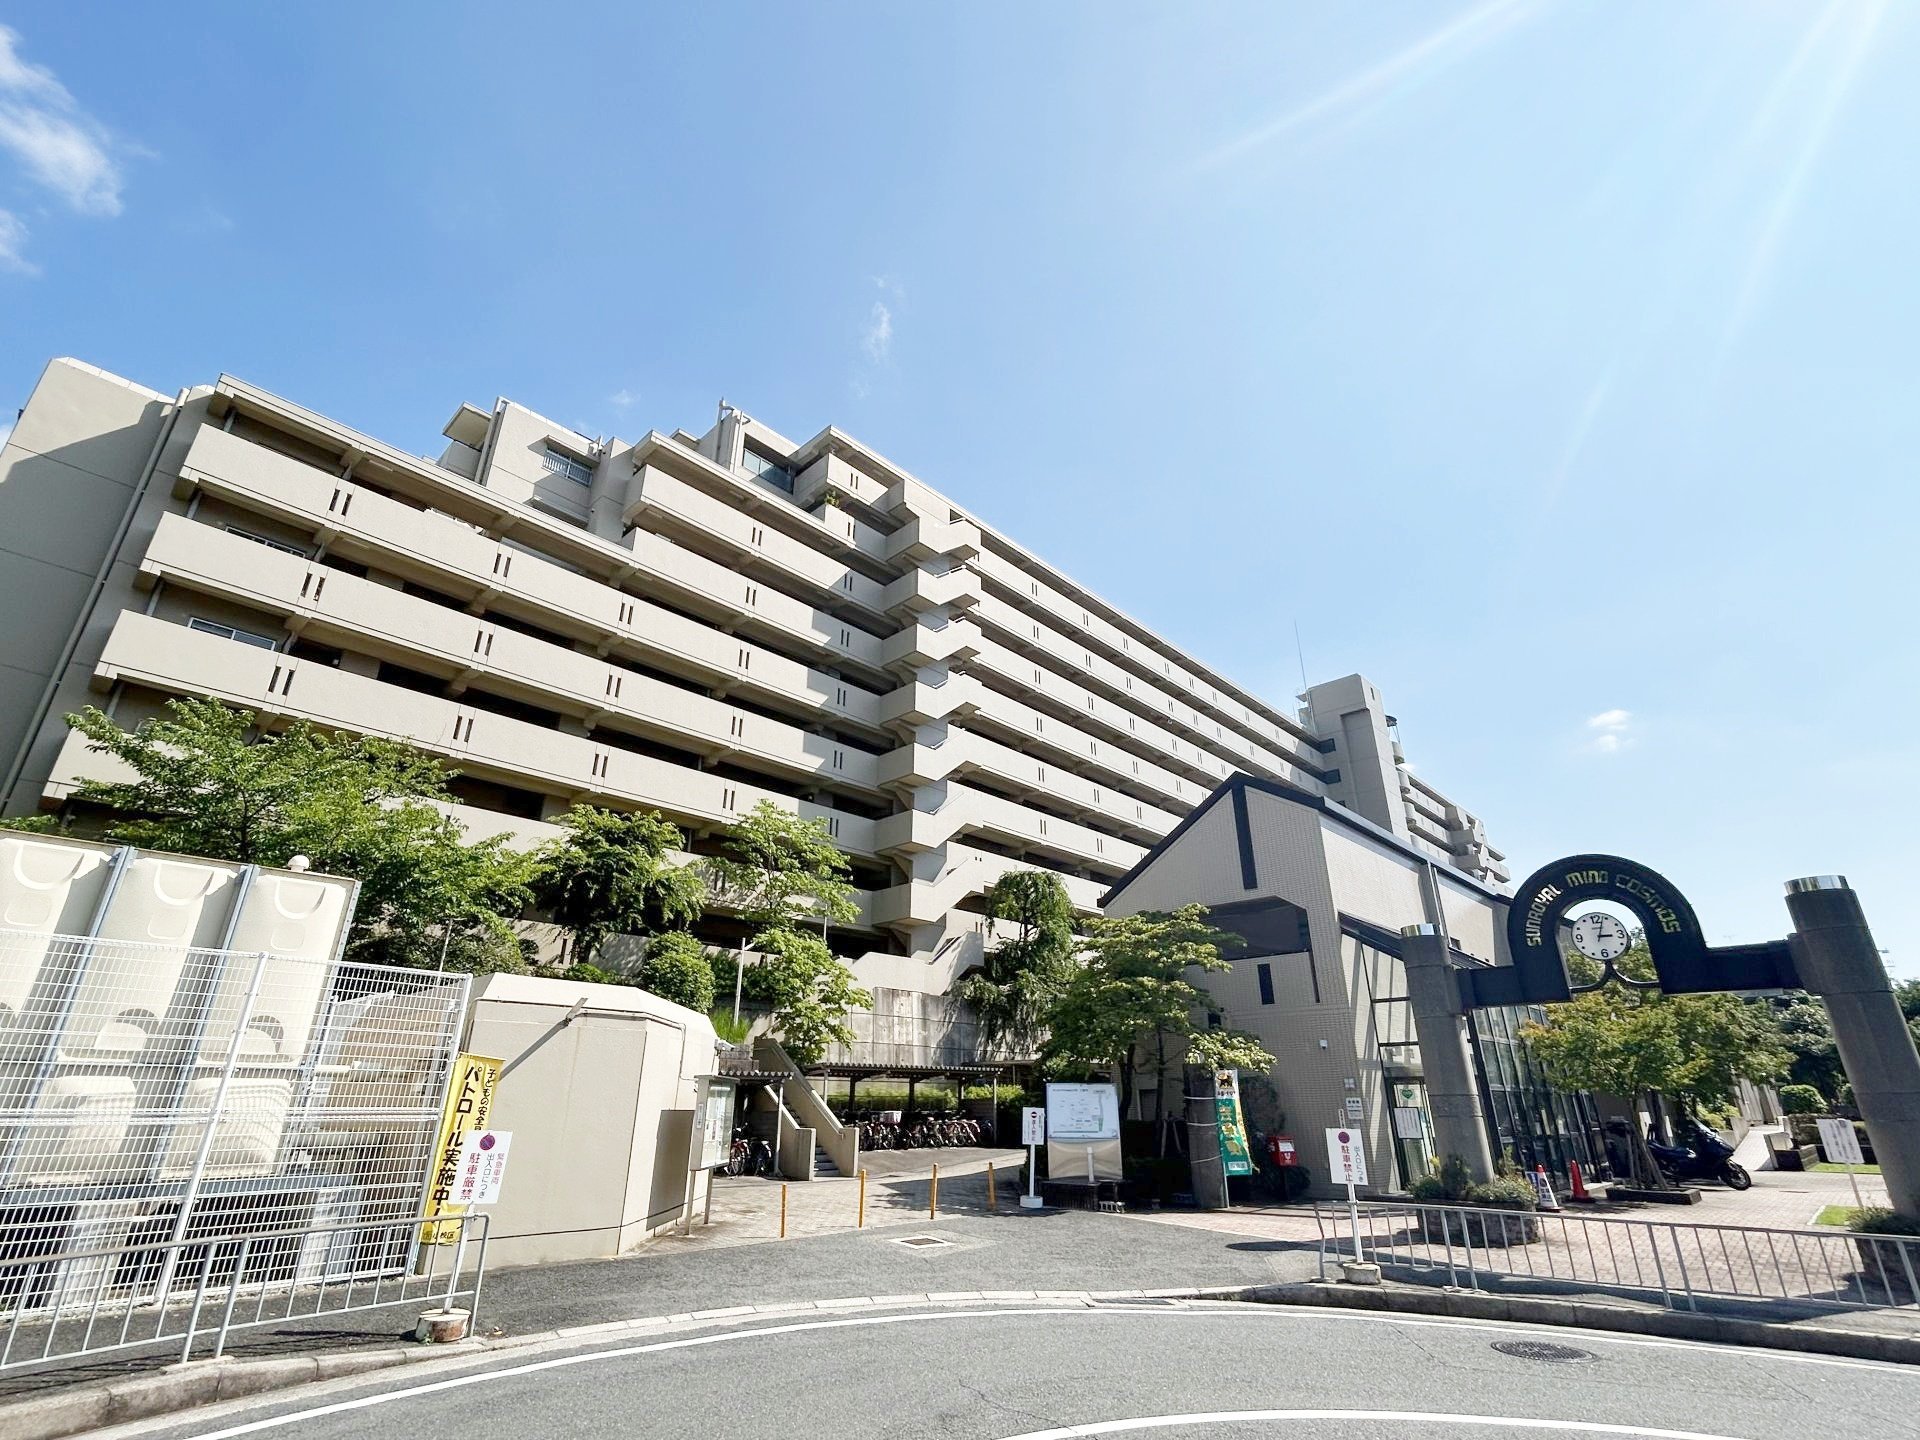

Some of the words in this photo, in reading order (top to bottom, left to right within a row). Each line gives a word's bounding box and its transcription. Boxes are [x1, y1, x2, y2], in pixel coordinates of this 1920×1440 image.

[1525, 884, 1563, 947] SUNROYAL
[1615, 874, 1682, 934] COSMOS
[1590, 914, 1602, 925] 12
[1575, 933, 1583, 943] 9
[1616, 929, 1625, 939] 3
[1601, 948, 1609, 958] 6
[478, 1152, 495, 1199] 出入口につき
[1341, 1145, 1353, 1182] 駐車禁止
[460, 1152, 481, 1200] 駐車厳禁
